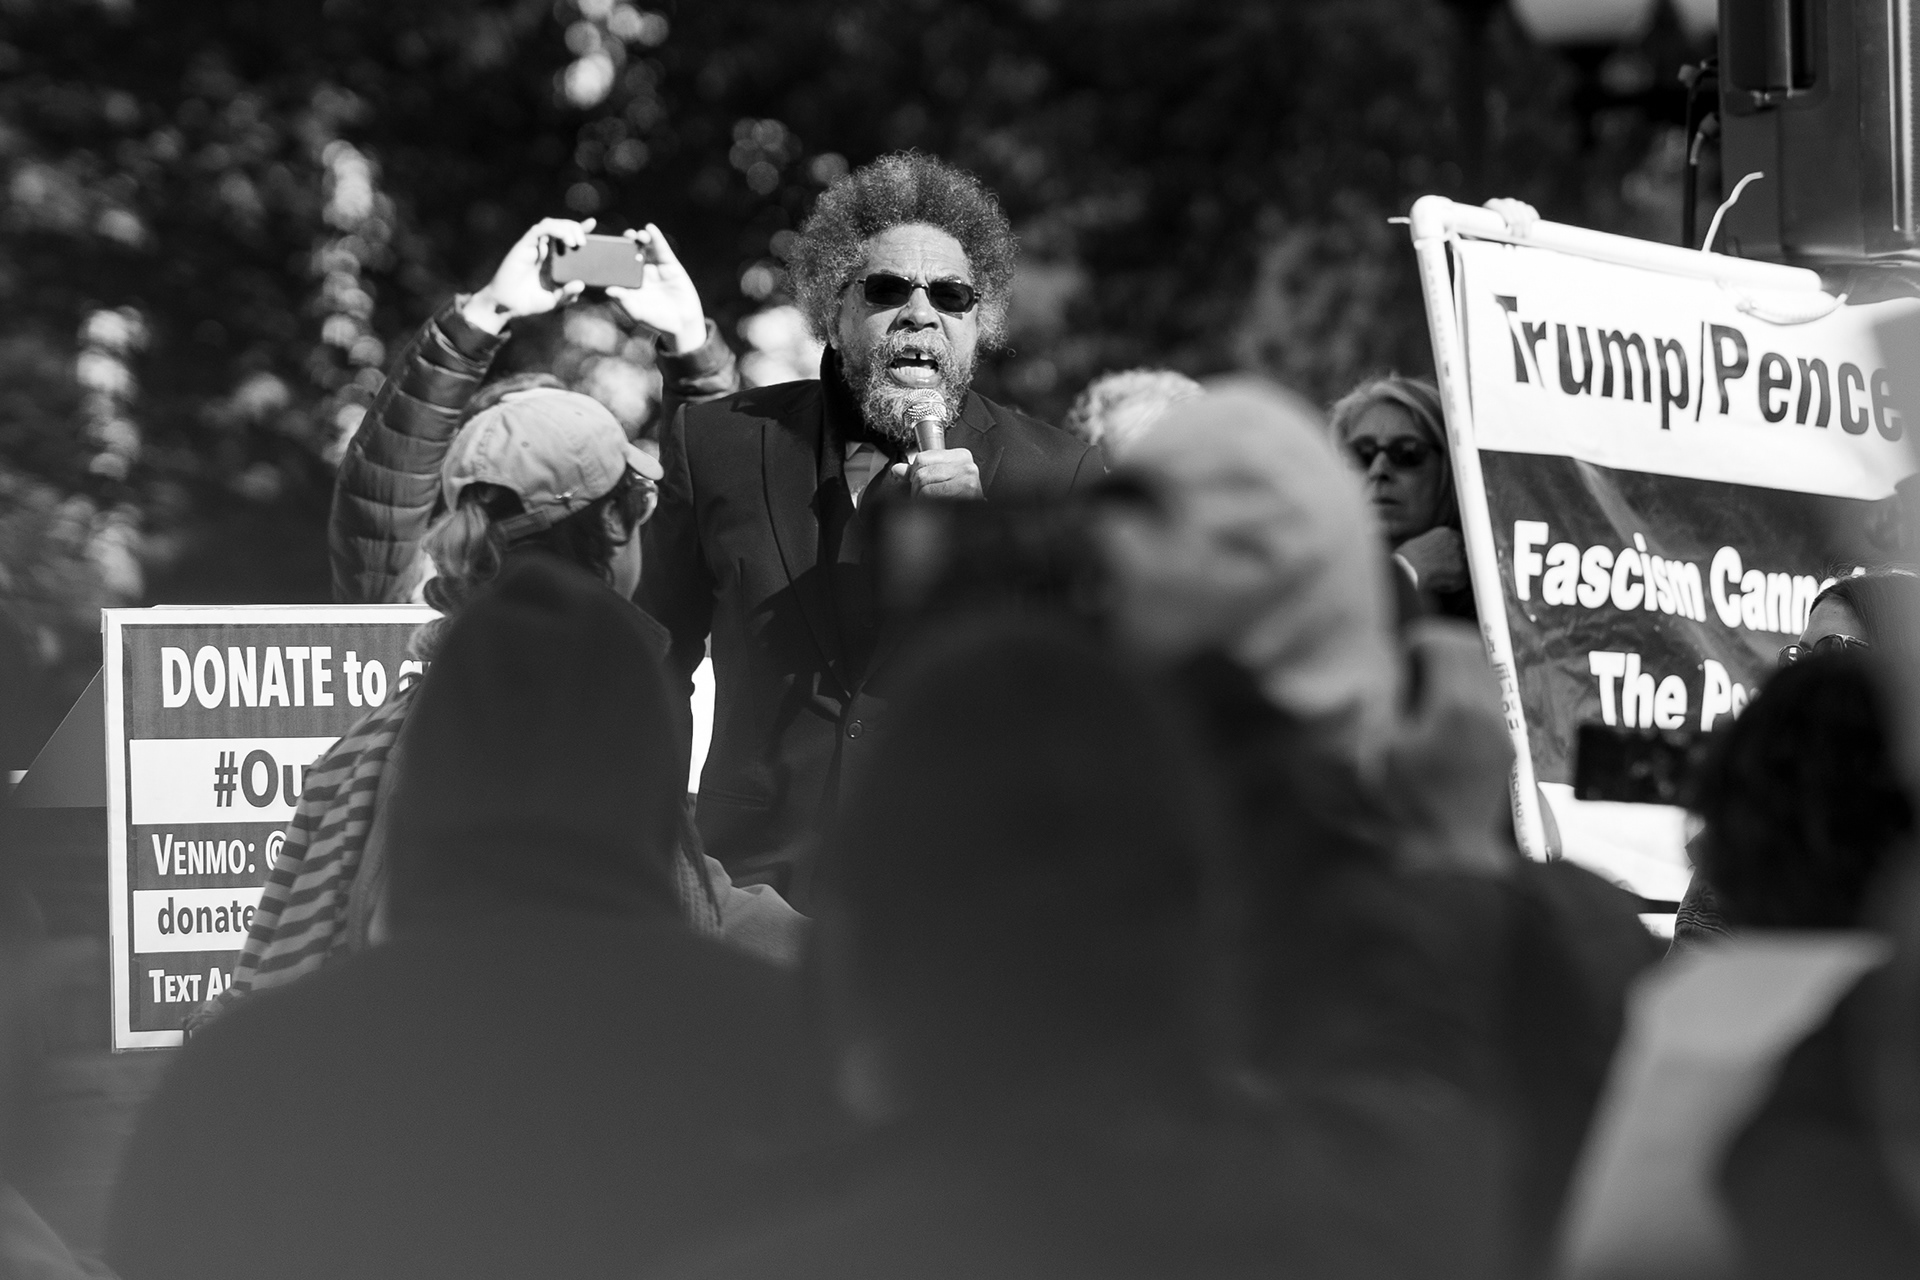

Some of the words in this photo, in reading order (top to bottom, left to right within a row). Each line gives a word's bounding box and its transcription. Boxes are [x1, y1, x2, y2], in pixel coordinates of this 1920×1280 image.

[1494, 294, 1903, 442] Trump/Pence
[1514, 520, 1707, 622] Fascism
[1710, 546, 1866, 635] Cann
[161, 645, 334, 709] DONATE
[343, 650, 387, 708] to
[1589, 650, 1688, 730] The
[213, 749, 320, 808] #Ou
[152, 833, 256, 876] VENMO:
[148, 969, 202, 1003] TEXT
